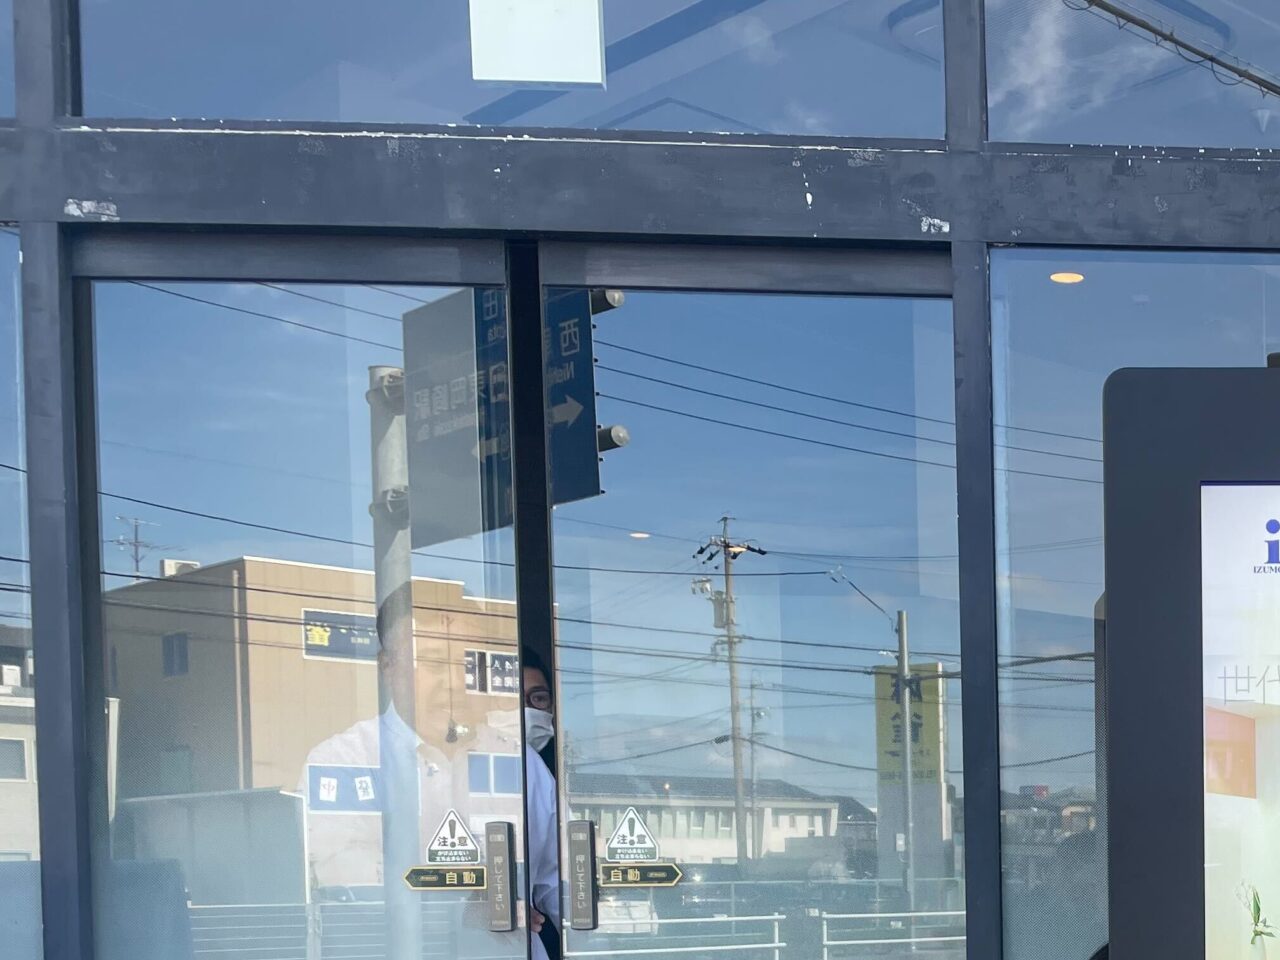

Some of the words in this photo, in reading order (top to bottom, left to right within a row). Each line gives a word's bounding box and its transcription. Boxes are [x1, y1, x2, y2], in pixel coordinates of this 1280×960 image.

[437, 836, 469, 847] 注意
[617, 834, 647, 845] 注意
[445, 871, 476, 885] 自動
[576, 854, 587, 909] 押して下さい
[611, 869, 641, 882] 自動
[494, 856, 505, 911] 押して下さい
